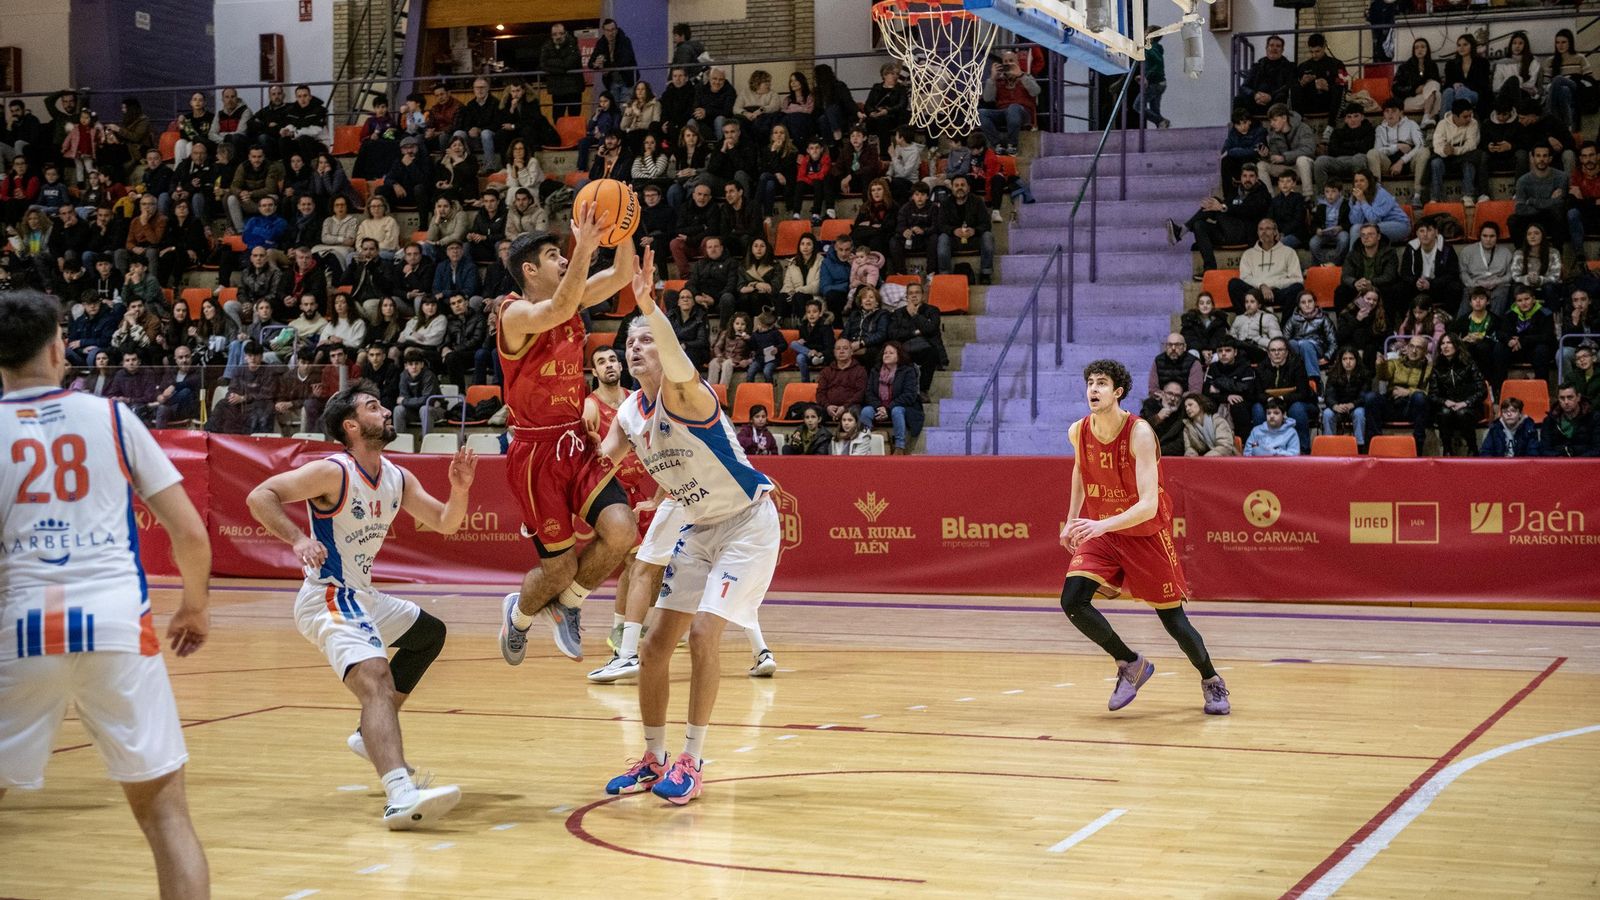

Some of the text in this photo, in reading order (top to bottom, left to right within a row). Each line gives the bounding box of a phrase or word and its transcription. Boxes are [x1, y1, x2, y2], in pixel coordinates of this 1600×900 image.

[11, 433, 90, 504] 28
[1099, 452, 1113, 469] 21
[369, 500, 382, 519] 14
[1508, 501, 1585, 533] Jaén
[459, 505, 499, 531] aén
[219, 525, 253, 537] PABLO
[829, 526, 916, 540] CAJA RURAL
[941, 516, 1030, 540] Blanca
[480, 532, 520, 542] INTERIOR
[942, 540, 991, 549] impresores
[1206, 531, 1320, 544] PABLO CARVAJAL
[1509, 533, 1600, 545] PARAÍSO INTERIO
[854, 539, 890, 555] JAÉN
[720, 581, 731, 599] 1
[1162, 582, 1173, 594] 21
